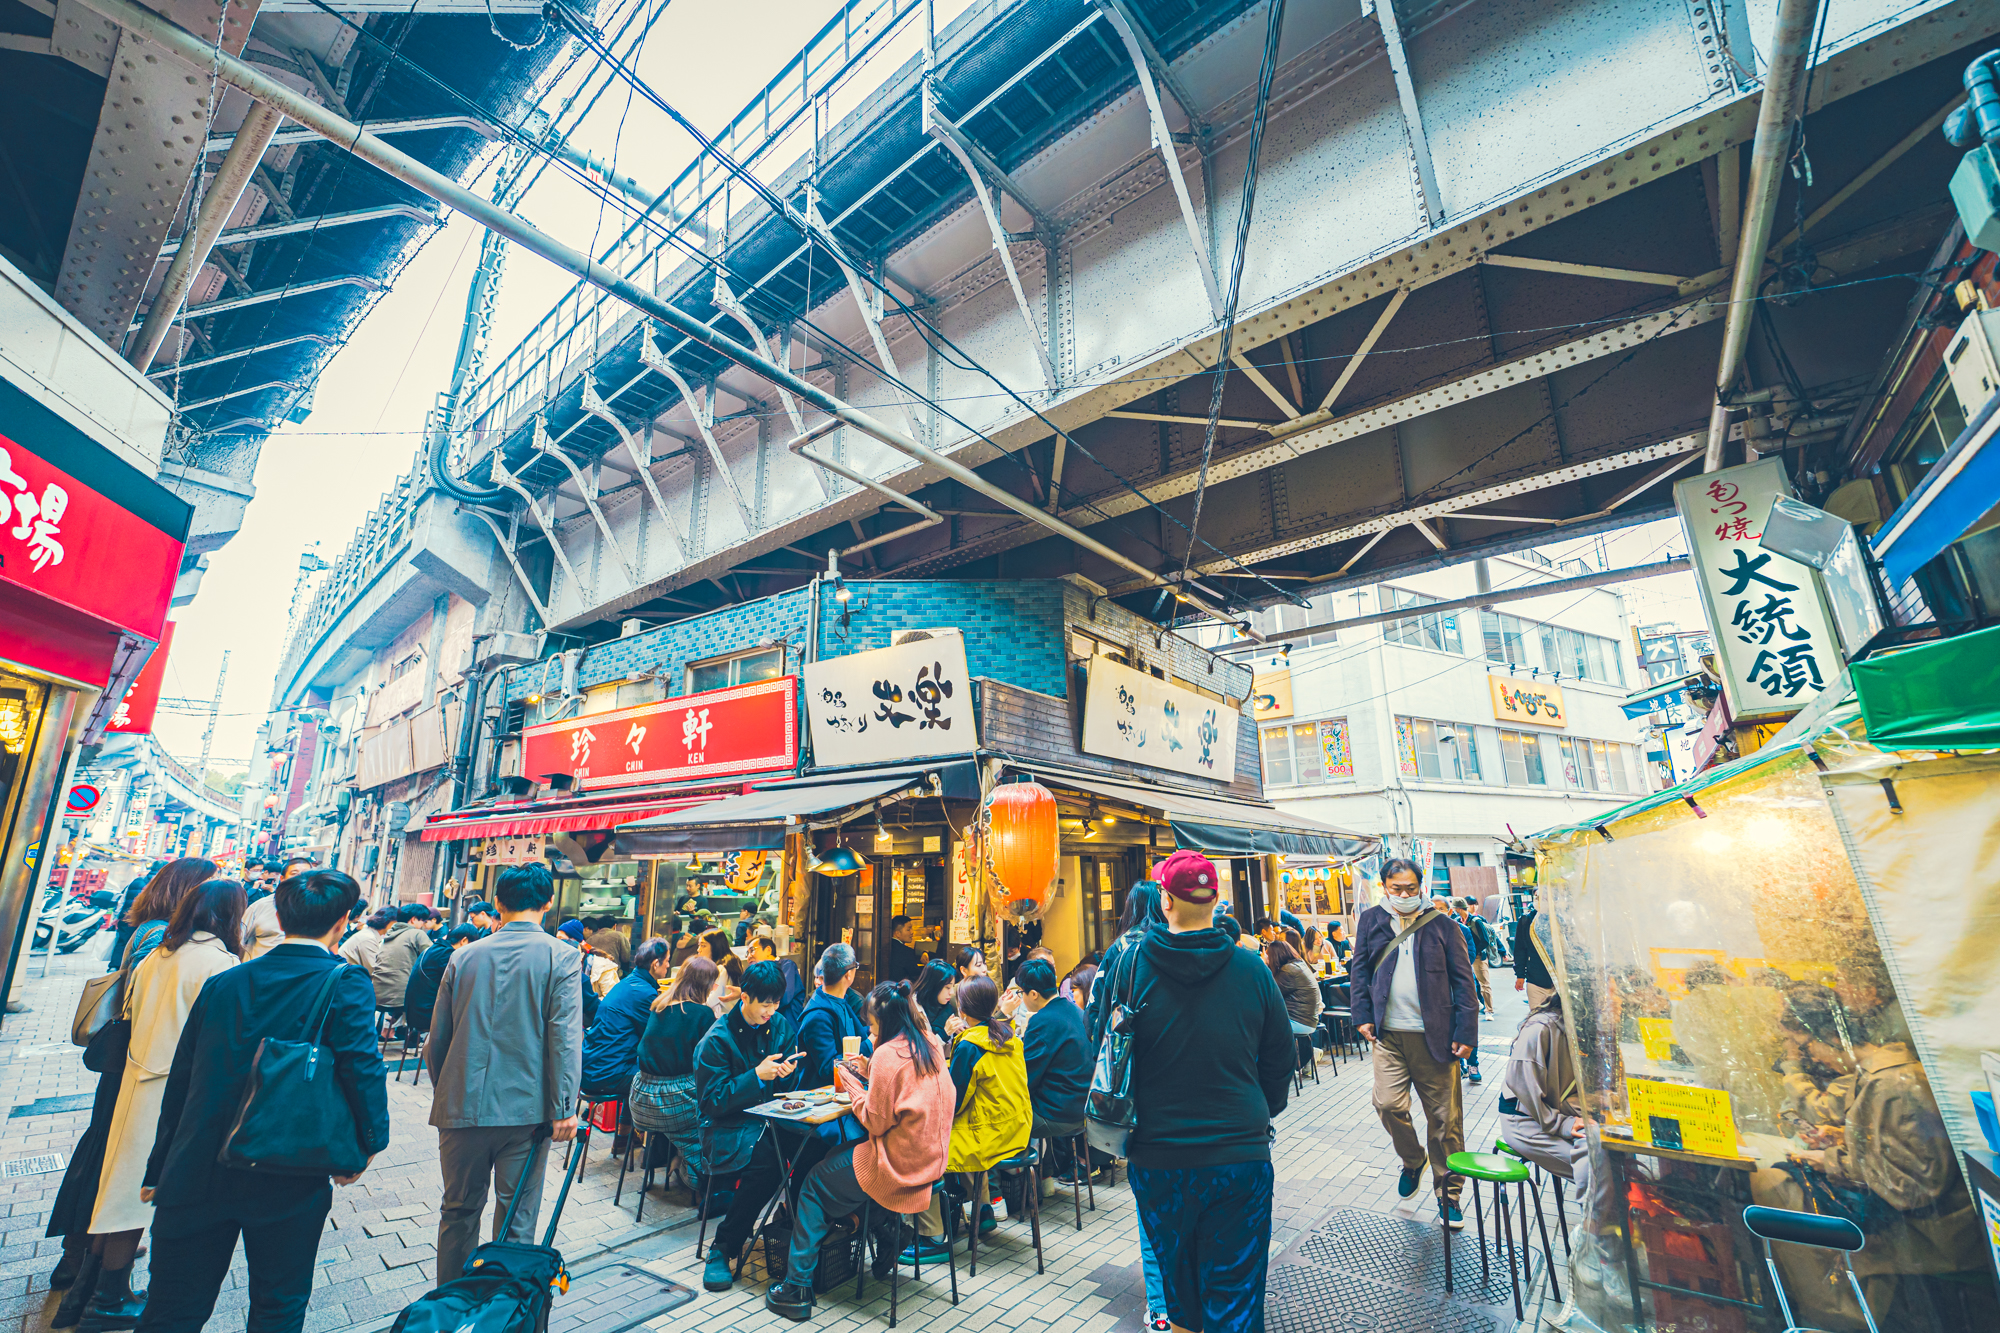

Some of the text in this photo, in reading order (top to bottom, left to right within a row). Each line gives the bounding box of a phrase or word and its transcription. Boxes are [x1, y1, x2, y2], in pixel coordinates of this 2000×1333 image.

[1718, 548, 1826, 698] 大統領
[1646, 640, 1679, 683] 大山
[570, 708, 713, 767] 珍々軒
[574, 752, 705, 778] CHIN CHIN KEN
[1328, 765, 1346, 774] 500
[167, 823, 178, 850] SLOT
[485, 842, 538, 857] 珍々軒
